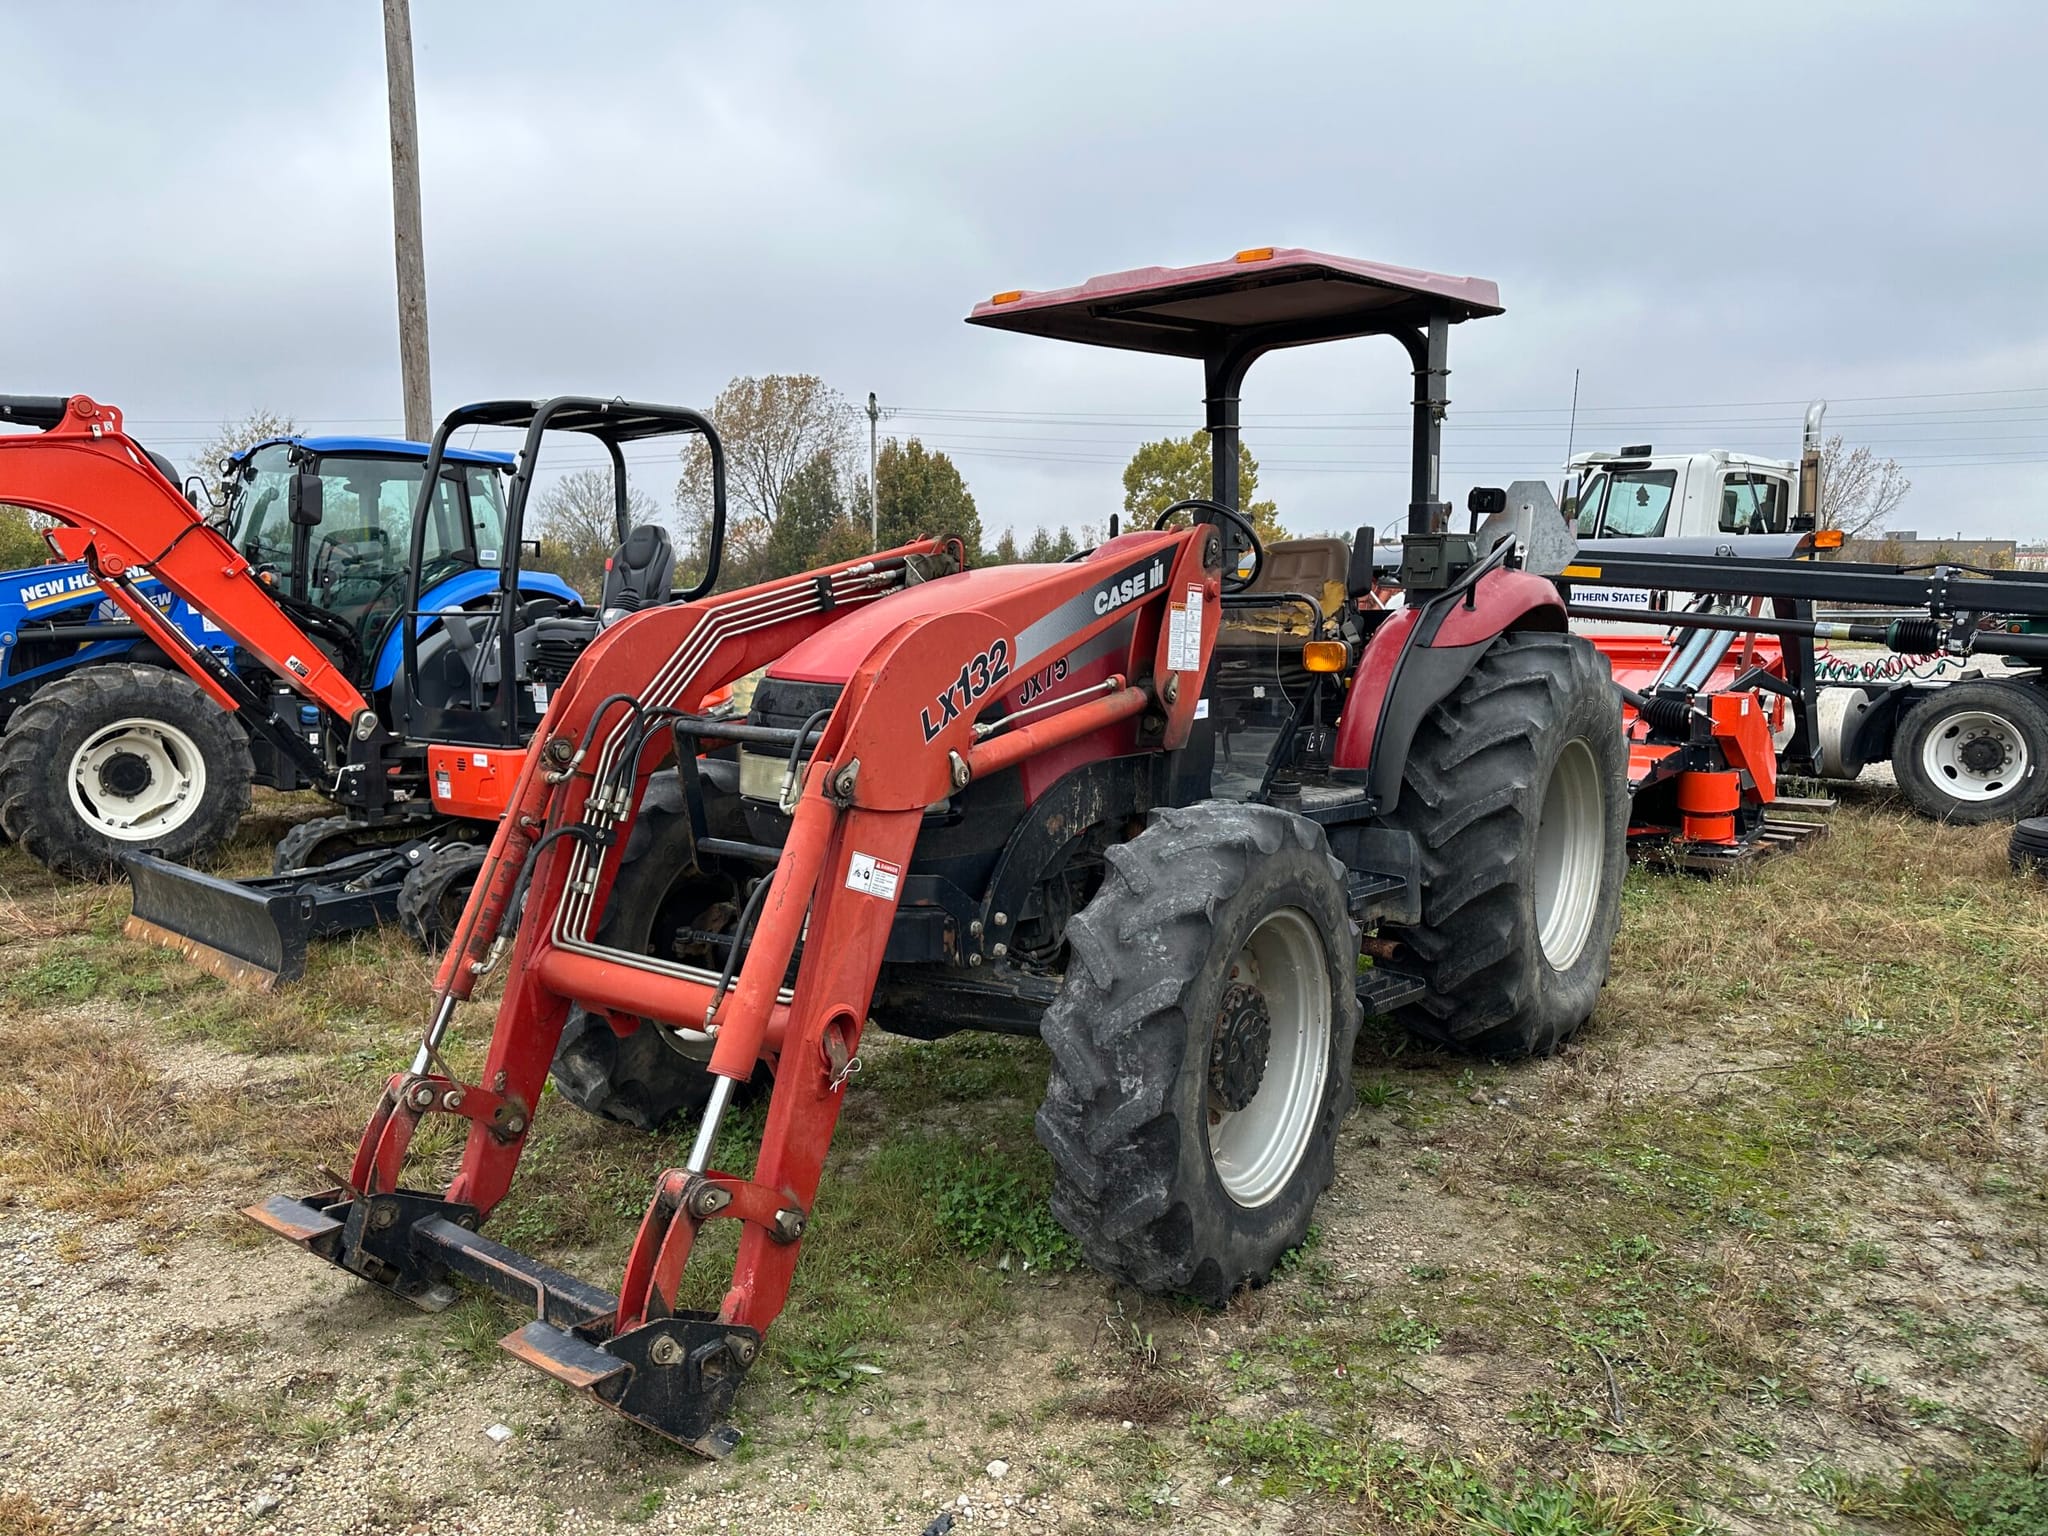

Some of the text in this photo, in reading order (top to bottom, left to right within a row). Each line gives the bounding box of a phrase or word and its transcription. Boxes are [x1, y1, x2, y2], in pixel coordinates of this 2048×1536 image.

[20, 579, 64, 603] NEW
[149, 591, 172, 607] EW
[1094, 572, 1146, 616] CASE
[1570, 592, 1648, 603] UTHERN STATES
[920, 638, 1010, 745] LX132
